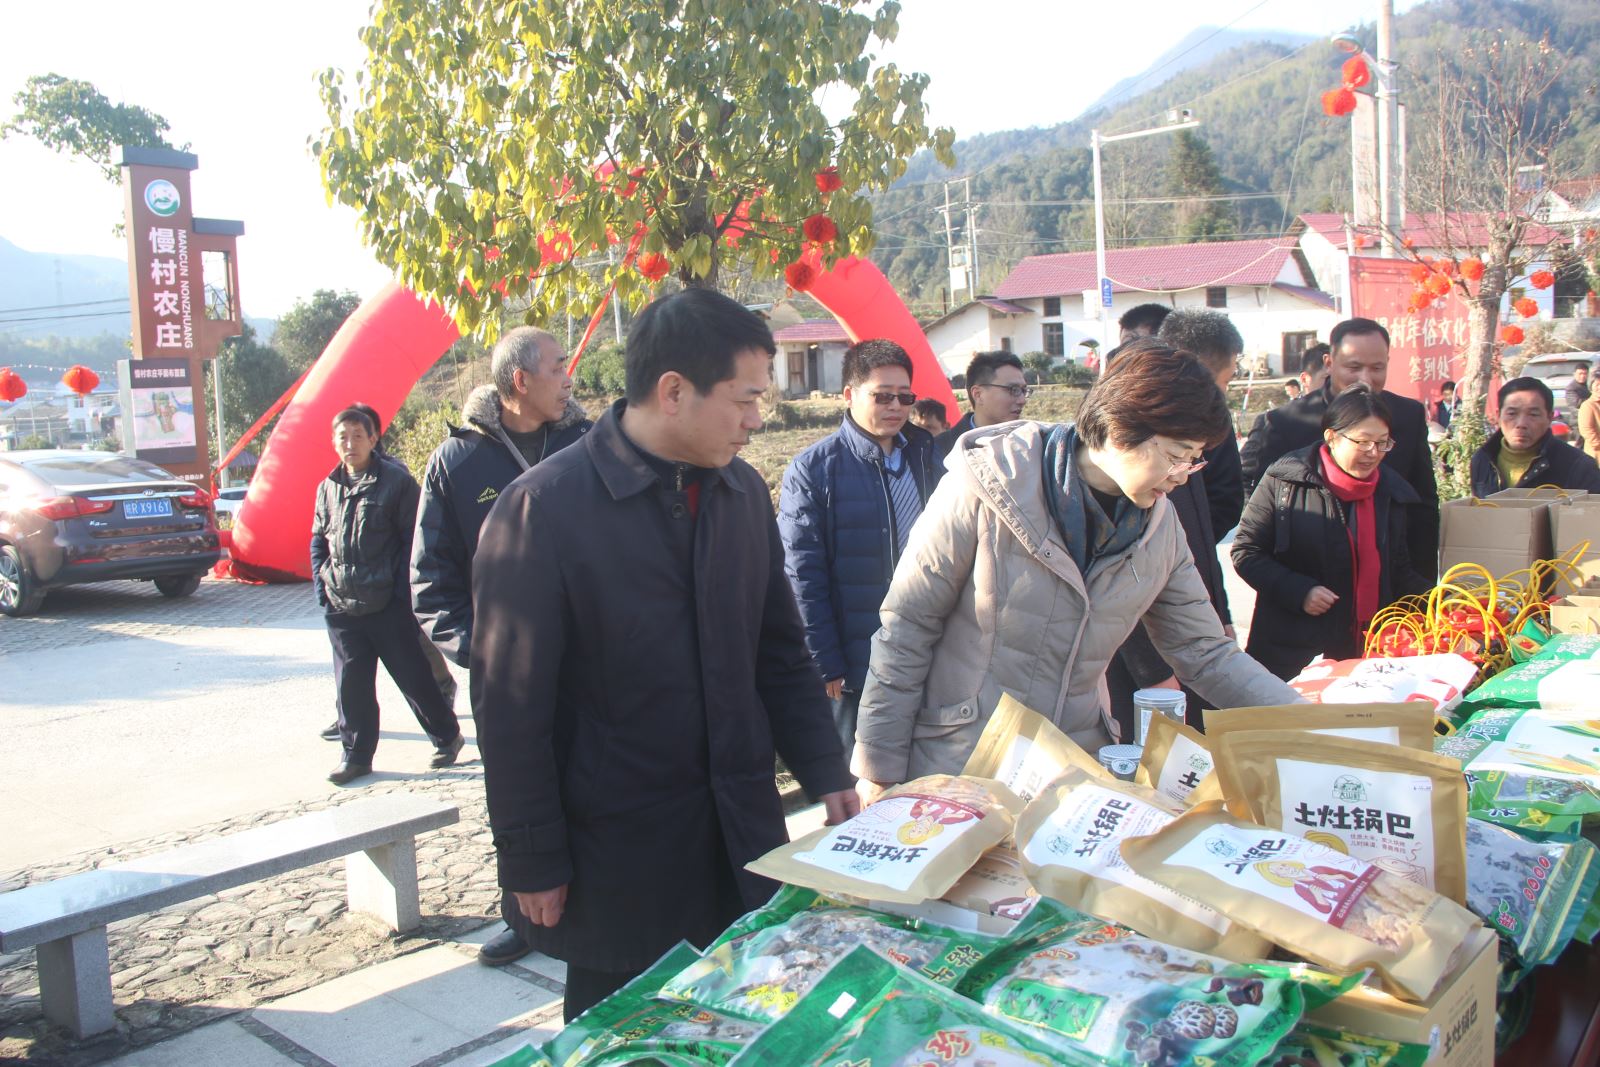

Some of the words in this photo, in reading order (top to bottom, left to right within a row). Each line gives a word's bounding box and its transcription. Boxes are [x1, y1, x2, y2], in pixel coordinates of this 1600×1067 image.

[178, 229, 189, 277] MANCUN
[149, 226, 182, 348] 慢村农庄
[180, 280, 193, 349] NONZHUANG
[1409, 355, 1450, 383] 签到处
[1074, 799, 1132, 857] 土灶锅巴
[1295, 802, 1414, 839] 土灶锅巴
[830, 835, 928, 863] 土灶锅巴
[1443, 1000, 1478, 1058] 土灶锅巴
